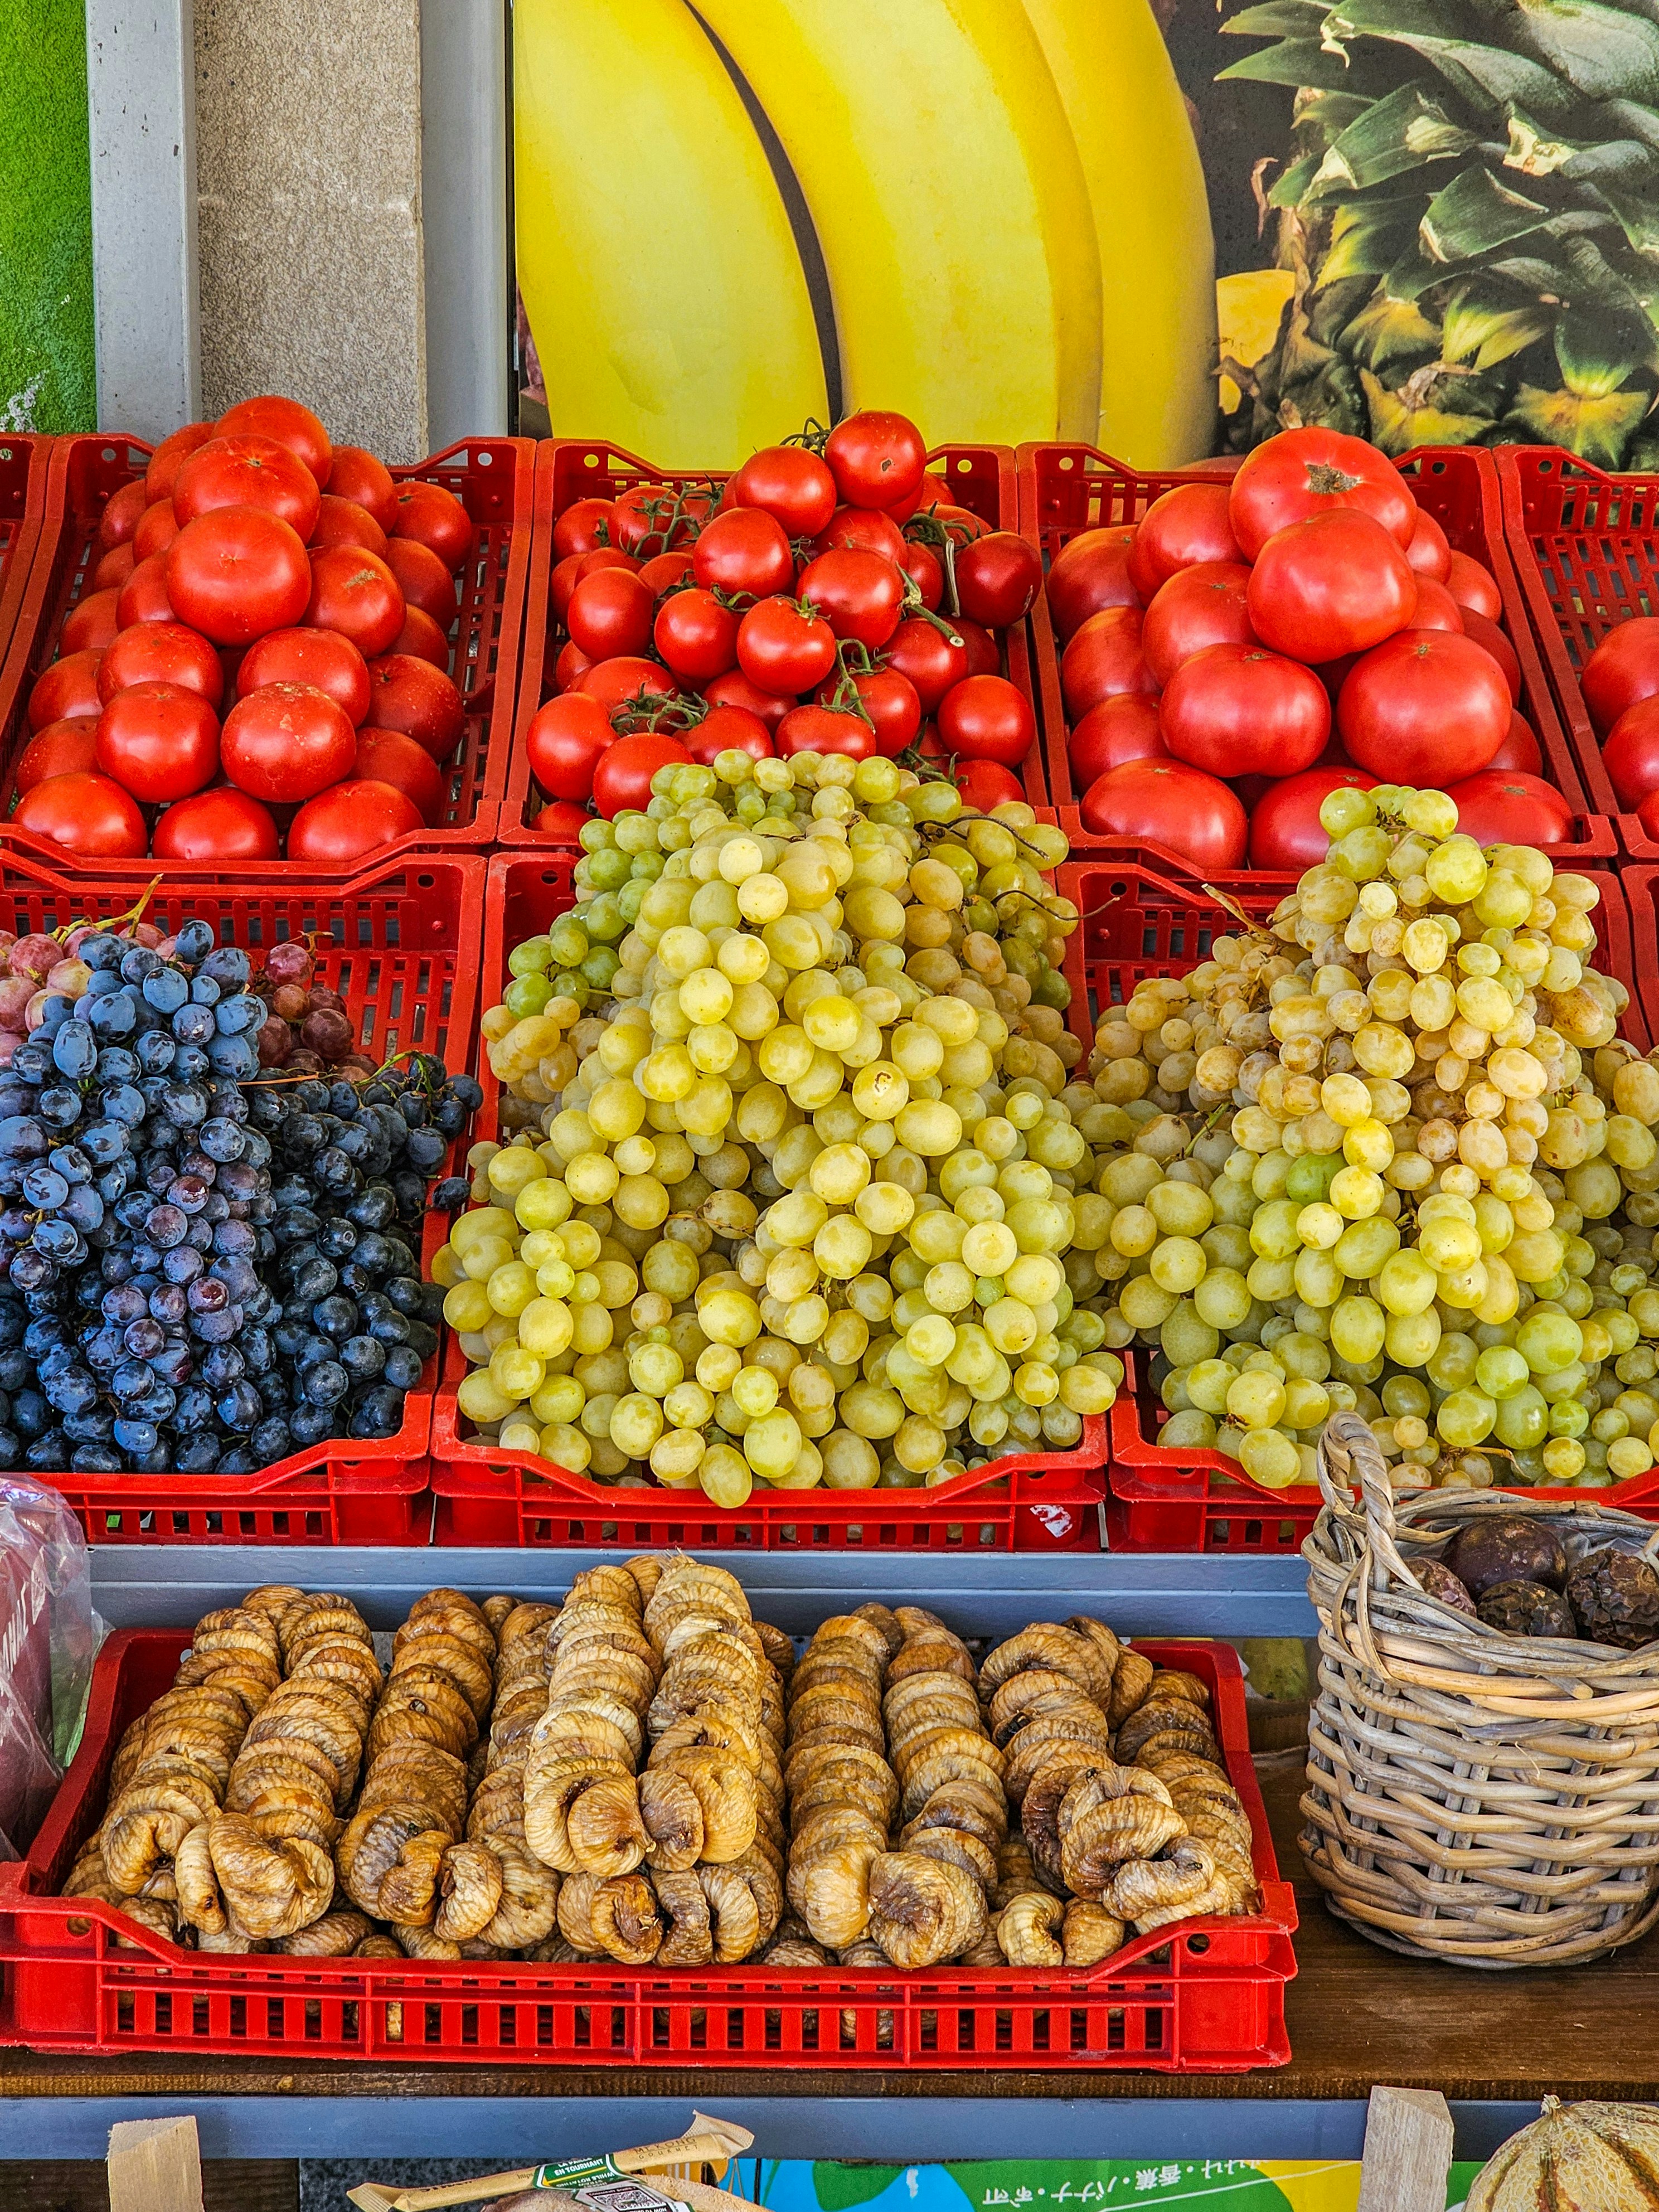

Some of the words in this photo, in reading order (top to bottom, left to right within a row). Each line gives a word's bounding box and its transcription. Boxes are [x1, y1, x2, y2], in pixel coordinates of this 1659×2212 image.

[633, 2138, 696, 2153] MEKONG
[639, 2145, 698, 2160] GOURMET
[554, 2168, 566, 2176] EN
[565, 2158, 604, 2172] TOURNANT
[591, 2171, 615, 2181] WHILE
[1134, 2163, 1181, 2191] 香蕉
[1051, 2176, 1118, 2203] バナナ
